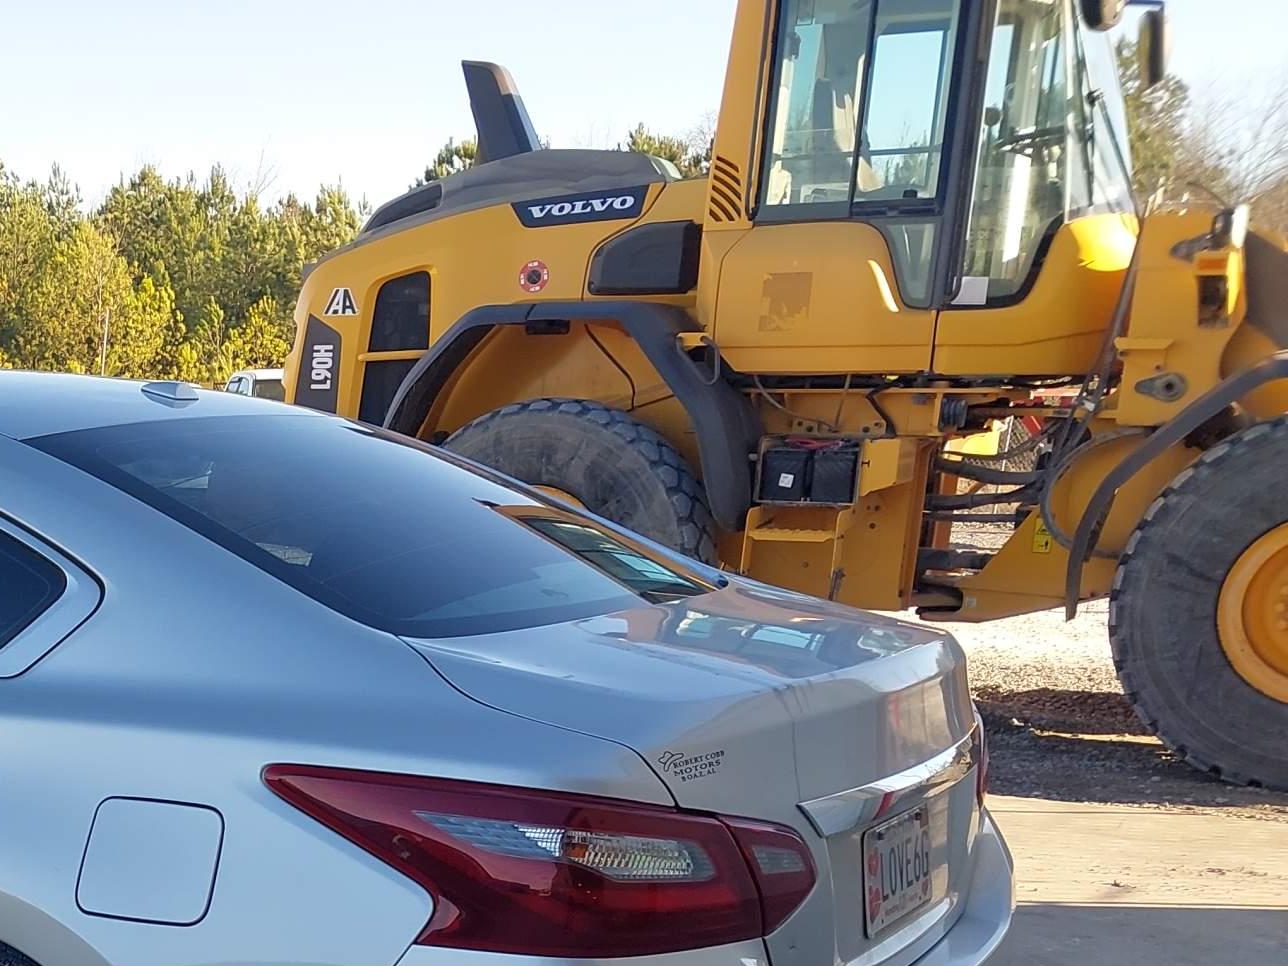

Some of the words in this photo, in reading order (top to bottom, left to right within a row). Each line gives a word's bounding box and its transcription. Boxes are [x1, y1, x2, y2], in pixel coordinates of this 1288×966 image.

[528, 196, 635, 218] VOLVO
[310, 344, 334, 390] L90H
[673, 755, 704, 769] ROBERT
[705, 750, 725, 761] COBB
[673, 759, 721, 777] MOTORS
[879, 830, 929, 902] LOVE6G
